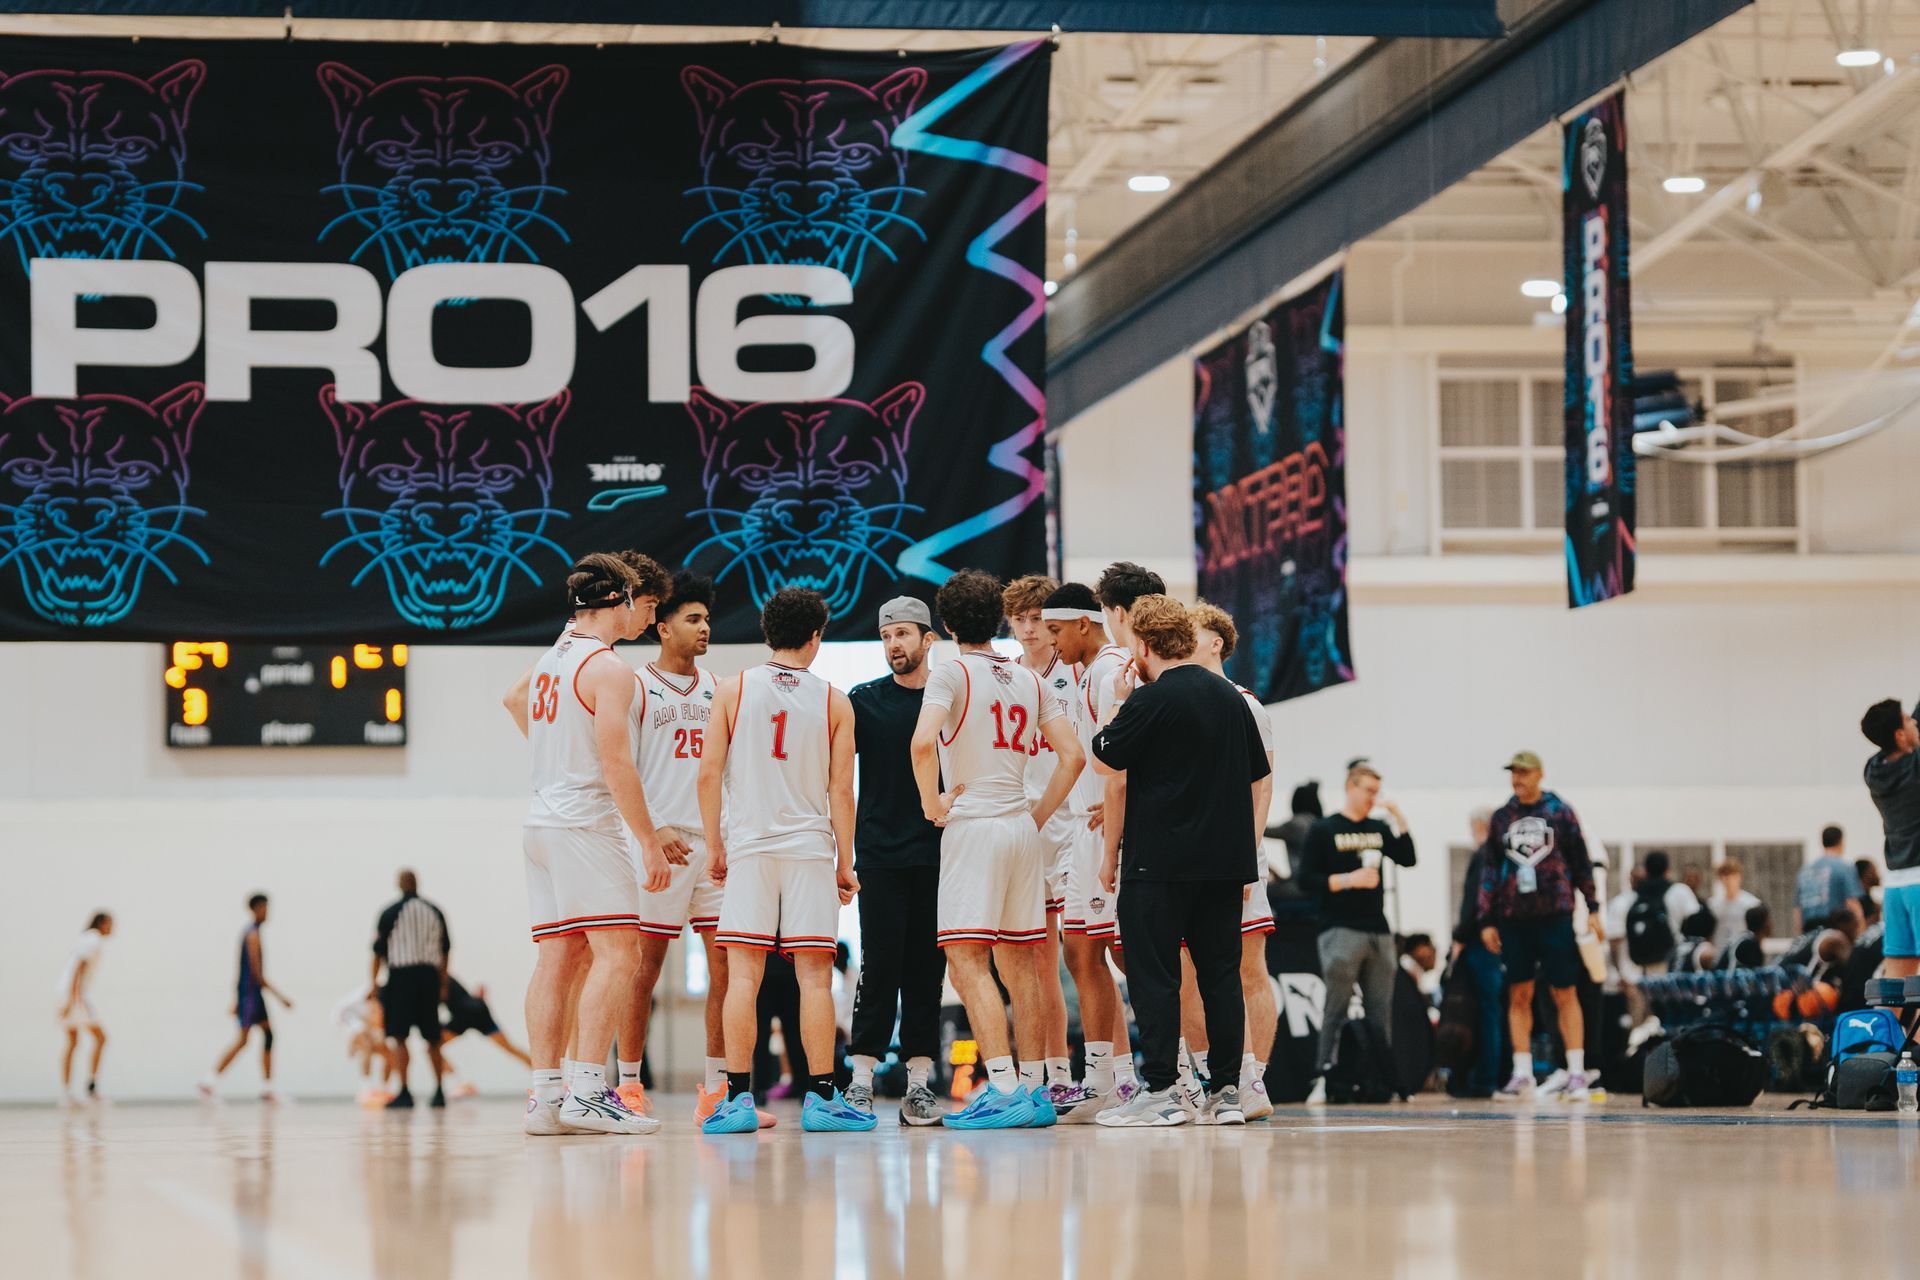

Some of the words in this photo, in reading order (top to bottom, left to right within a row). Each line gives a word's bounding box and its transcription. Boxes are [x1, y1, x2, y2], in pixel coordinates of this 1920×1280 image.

[29, 257, 855, 404] PRO16
[587, 463, 662, 481] NITRO
[532, 672, 560, 724] 35
[653, 705, 677, 729] AAO
[681, 703, 711, 722] FLIGH
[674, 728, 703, 758] 25
[771, 709, 788, 760] 1
[990, 699, 1027, 753] 12
